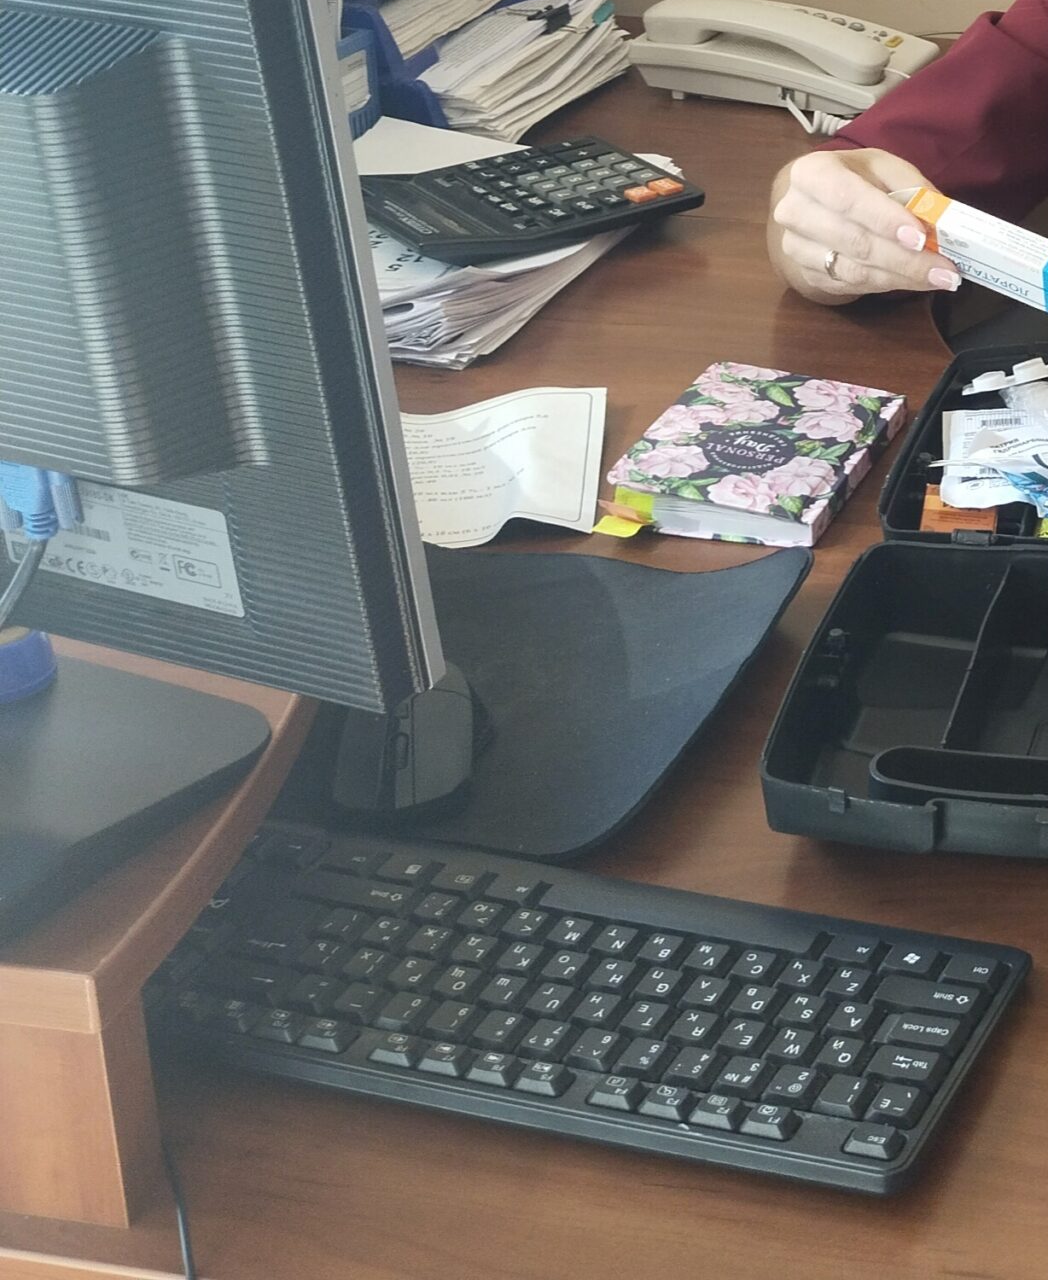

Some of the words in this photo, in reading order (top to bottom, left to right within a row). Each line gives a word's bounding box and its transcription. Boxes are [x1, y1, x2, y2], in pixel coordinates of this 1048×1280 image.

[733, 435, 776, 452] Day
[706, 443, 786, 464] PERSONAL
[564, 932, 580, 941] M
[611, 940, 626, 949] N
[658, 949, 671, 958] B
[703, 957, 714, 966] V
[798, 974, 810, 983] X
[656, 983, 669, 993] G
[847, 982, 859, 992] Z
[704, 993, 717, 1002] F
[751, 1001, 764, 1010] D
[801, 1009, 813, 1019] S
[641, 1017, 653, 1026] T
[692, 1026, 705, 1036] R
[902, 1022, 924, 1031] Lock
[925, 1026, 949, 1036] Caps
[784, 1044, 800, 1054] W
[838, 1052, 851, 1063] Q
[750, 1063, 760, 1071] 3
[912, 1060, 928, 1070] Tab
[798, 1072, 809, 1081] 2
